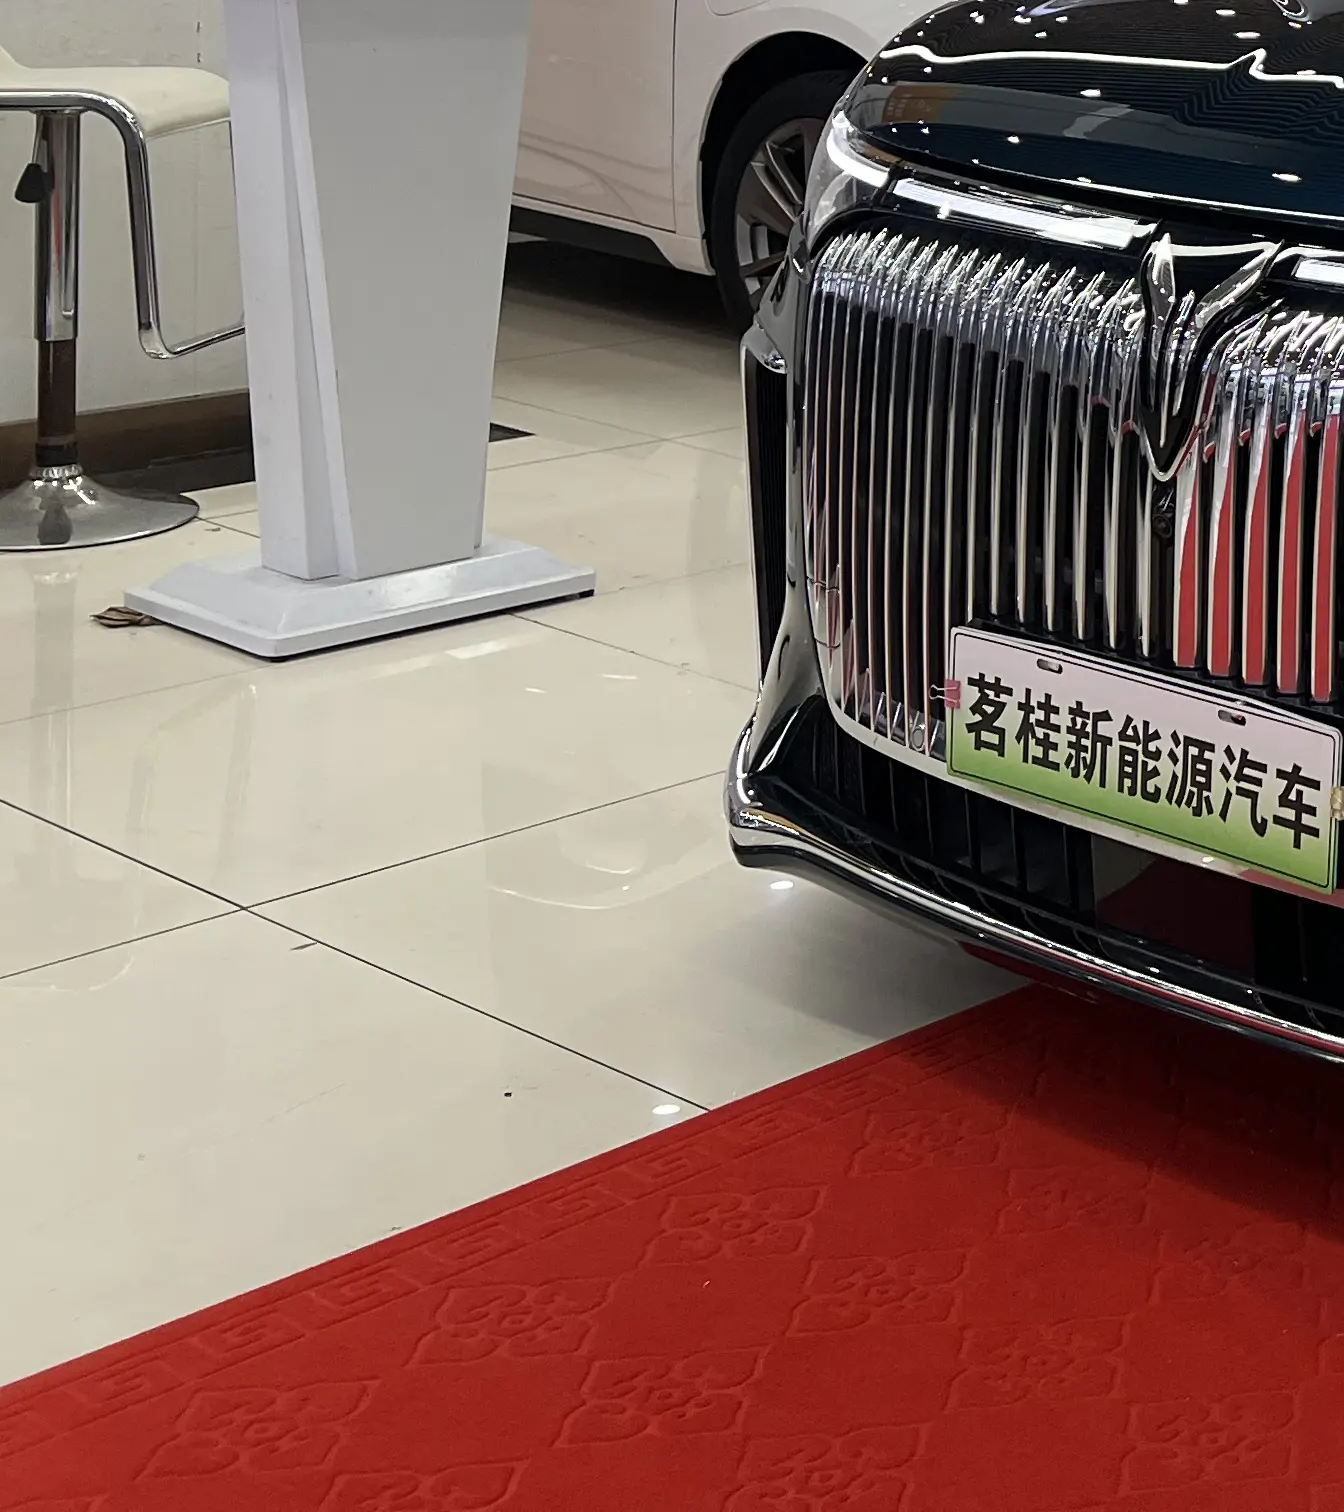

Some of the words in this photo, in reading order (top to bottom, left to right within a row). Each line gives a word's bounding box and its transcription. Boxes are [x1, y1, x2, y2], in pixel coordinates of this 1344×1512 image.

[965, 672, 1321, 849] 茗桂新能源汽车
